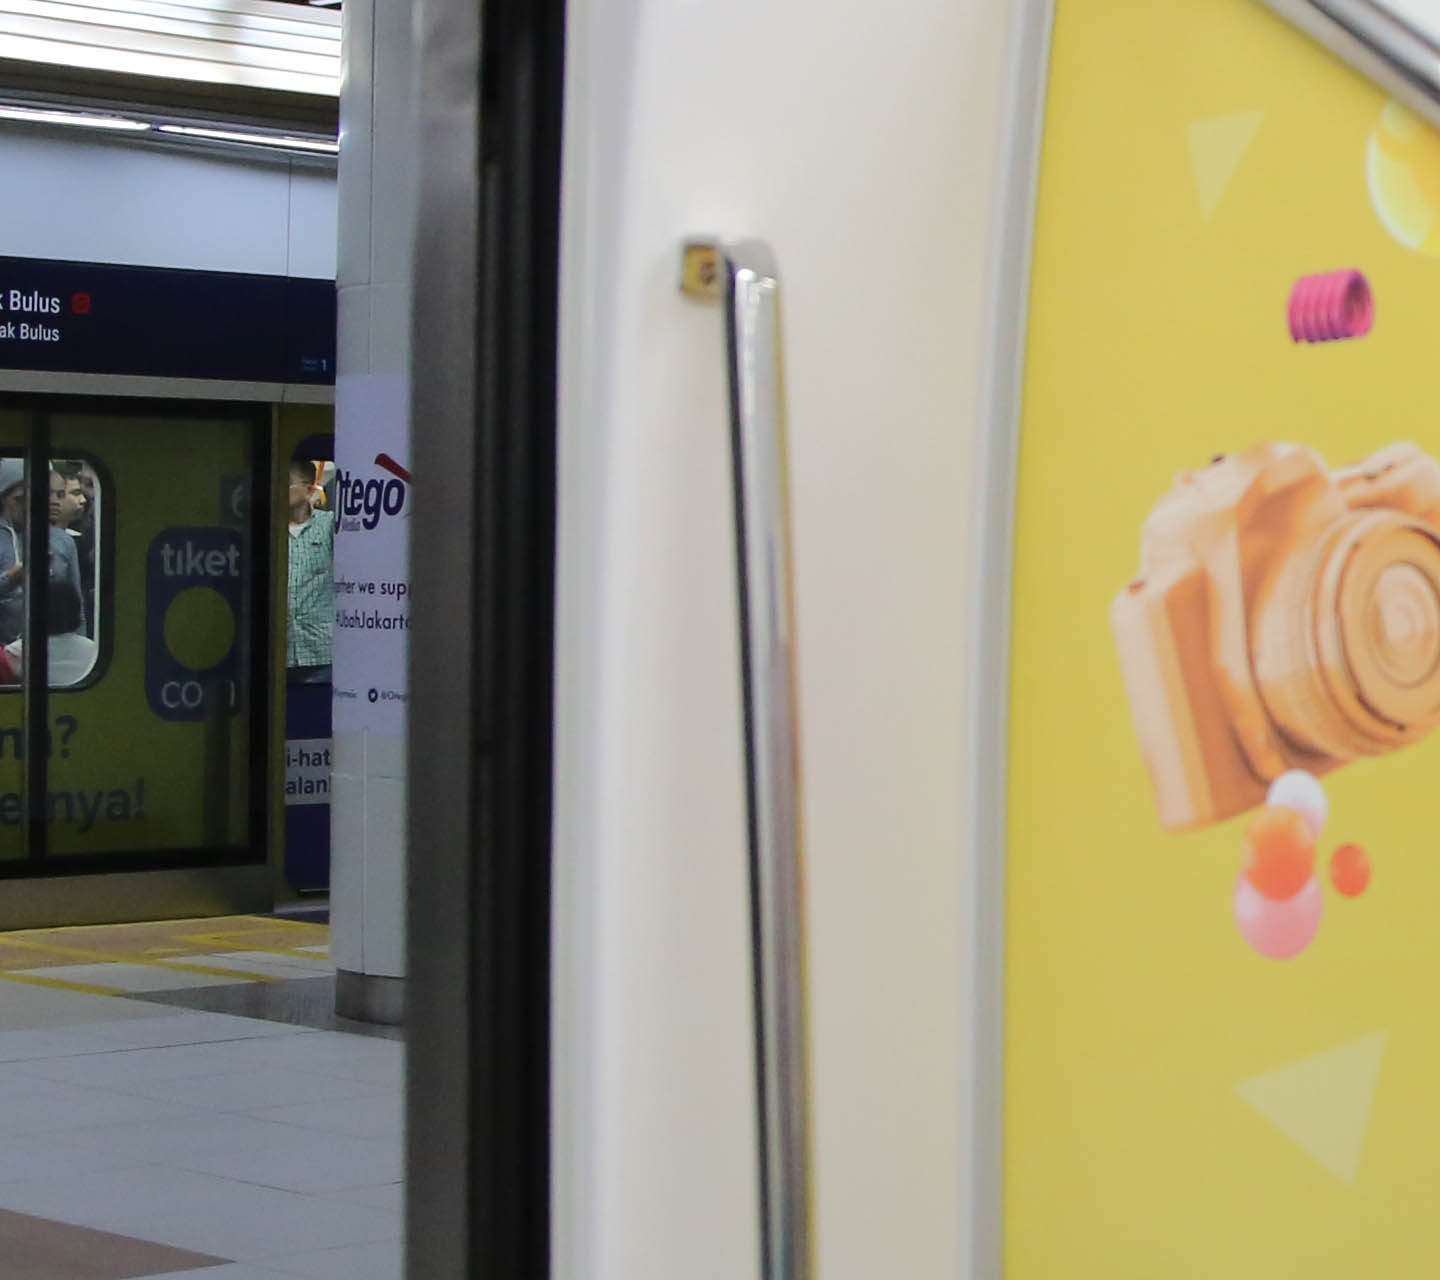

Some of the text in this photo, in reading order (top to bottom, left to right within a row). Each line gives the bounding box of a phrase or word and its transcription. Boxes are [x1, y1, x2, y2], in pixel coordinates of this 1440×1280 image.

[9, 289, 61, 314] Bulus
[19, 323, 60, 342] Bulus
[160, 540, 241, 577] tiket
[358, 582, 376, 596] we
